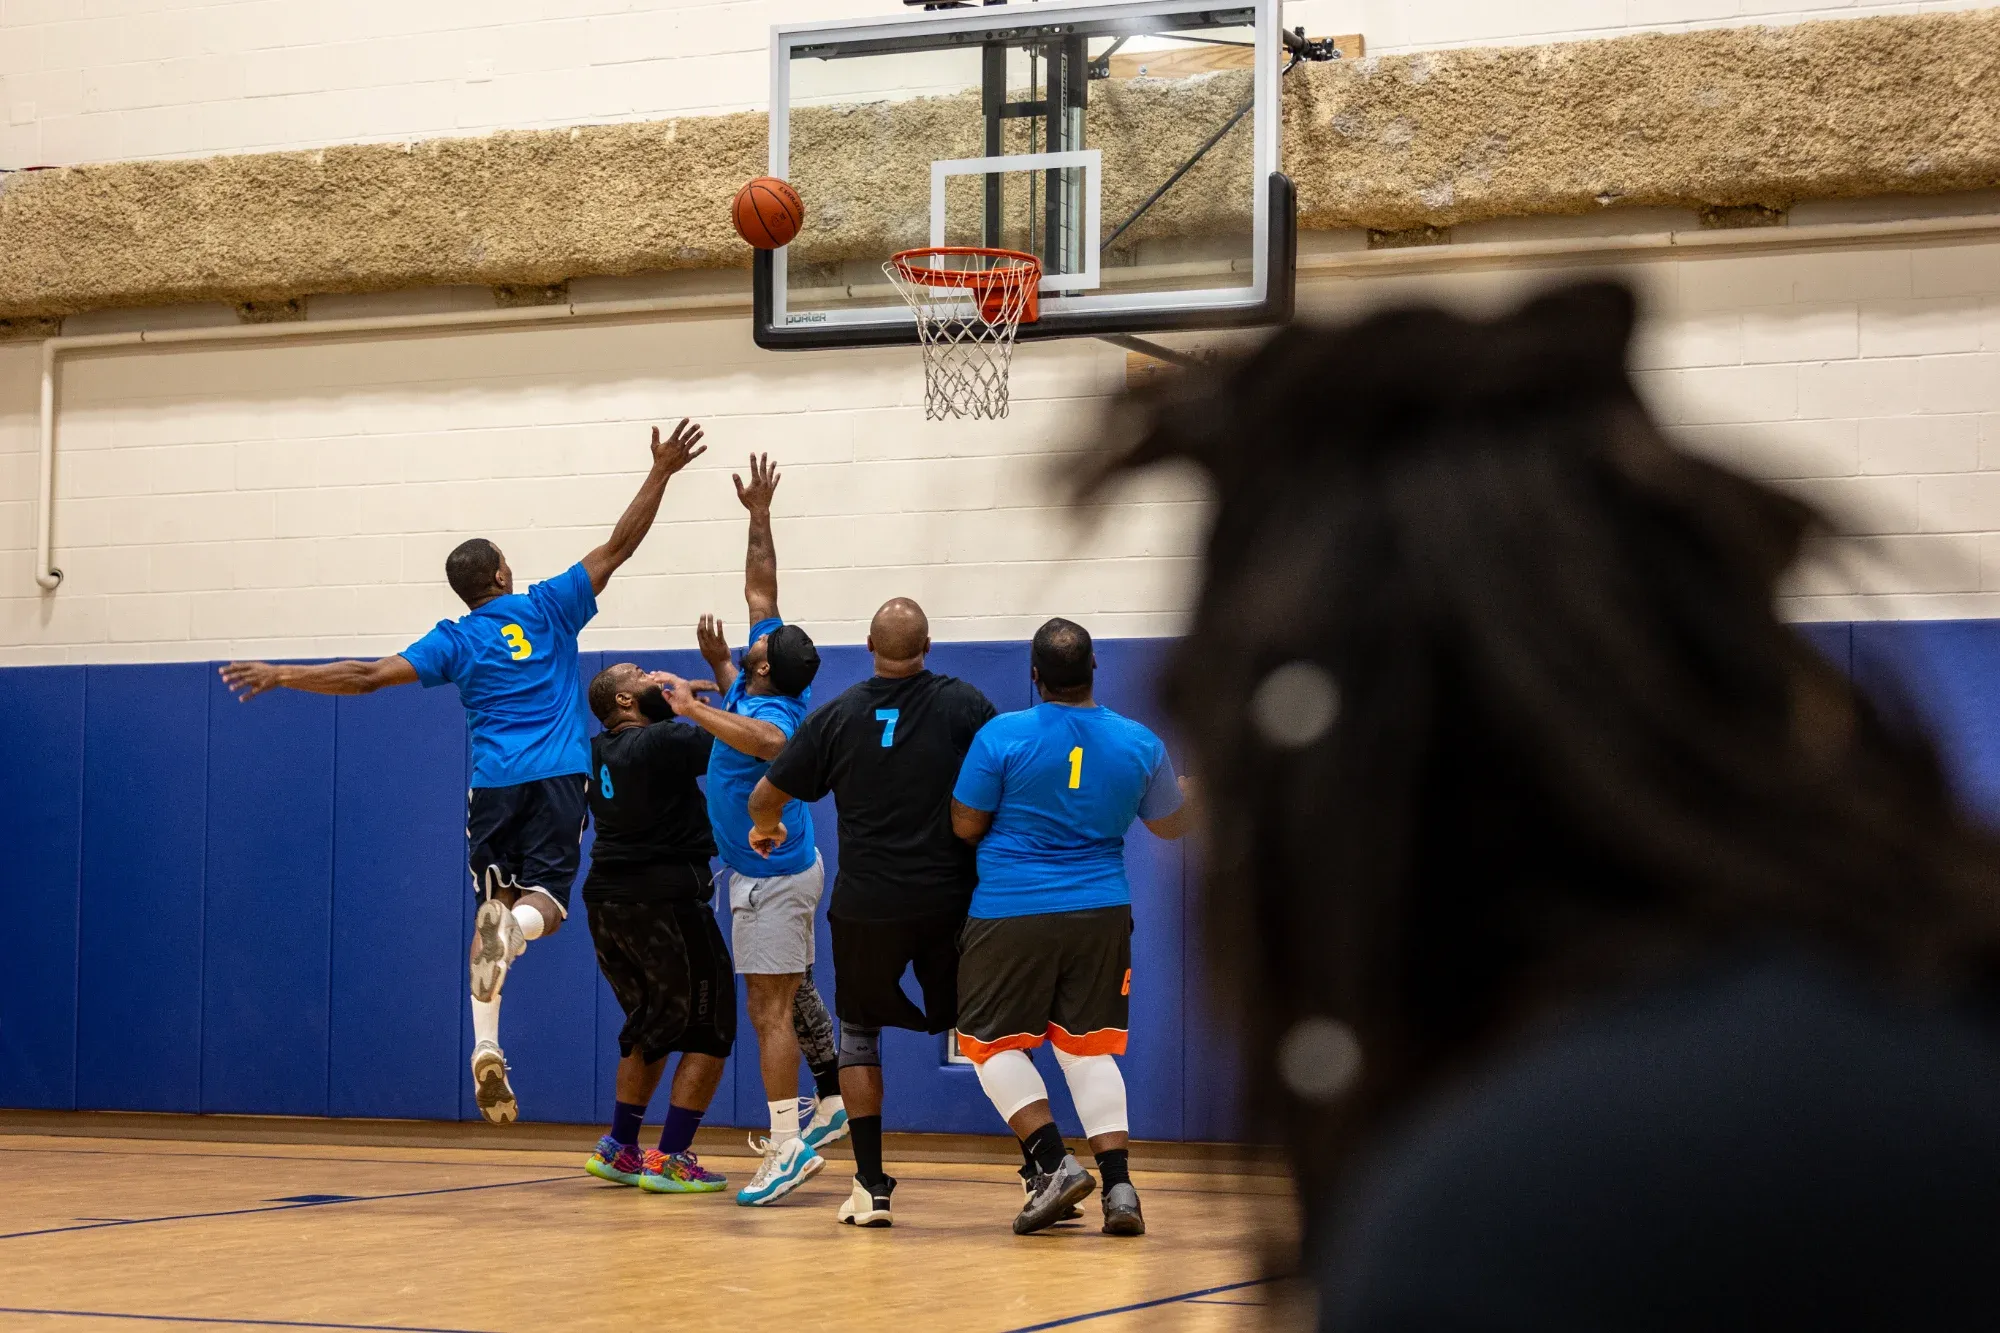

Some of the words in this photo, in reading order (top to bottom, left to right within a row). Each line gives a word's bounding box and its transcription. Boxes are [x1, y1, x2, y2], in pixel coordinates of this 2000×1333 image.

[501, 623, 532, 660] 3
[876, 709, 899, 747] 7
[601, 764, 614, 798] 8
[1069, 746, 1083, 788] 1
